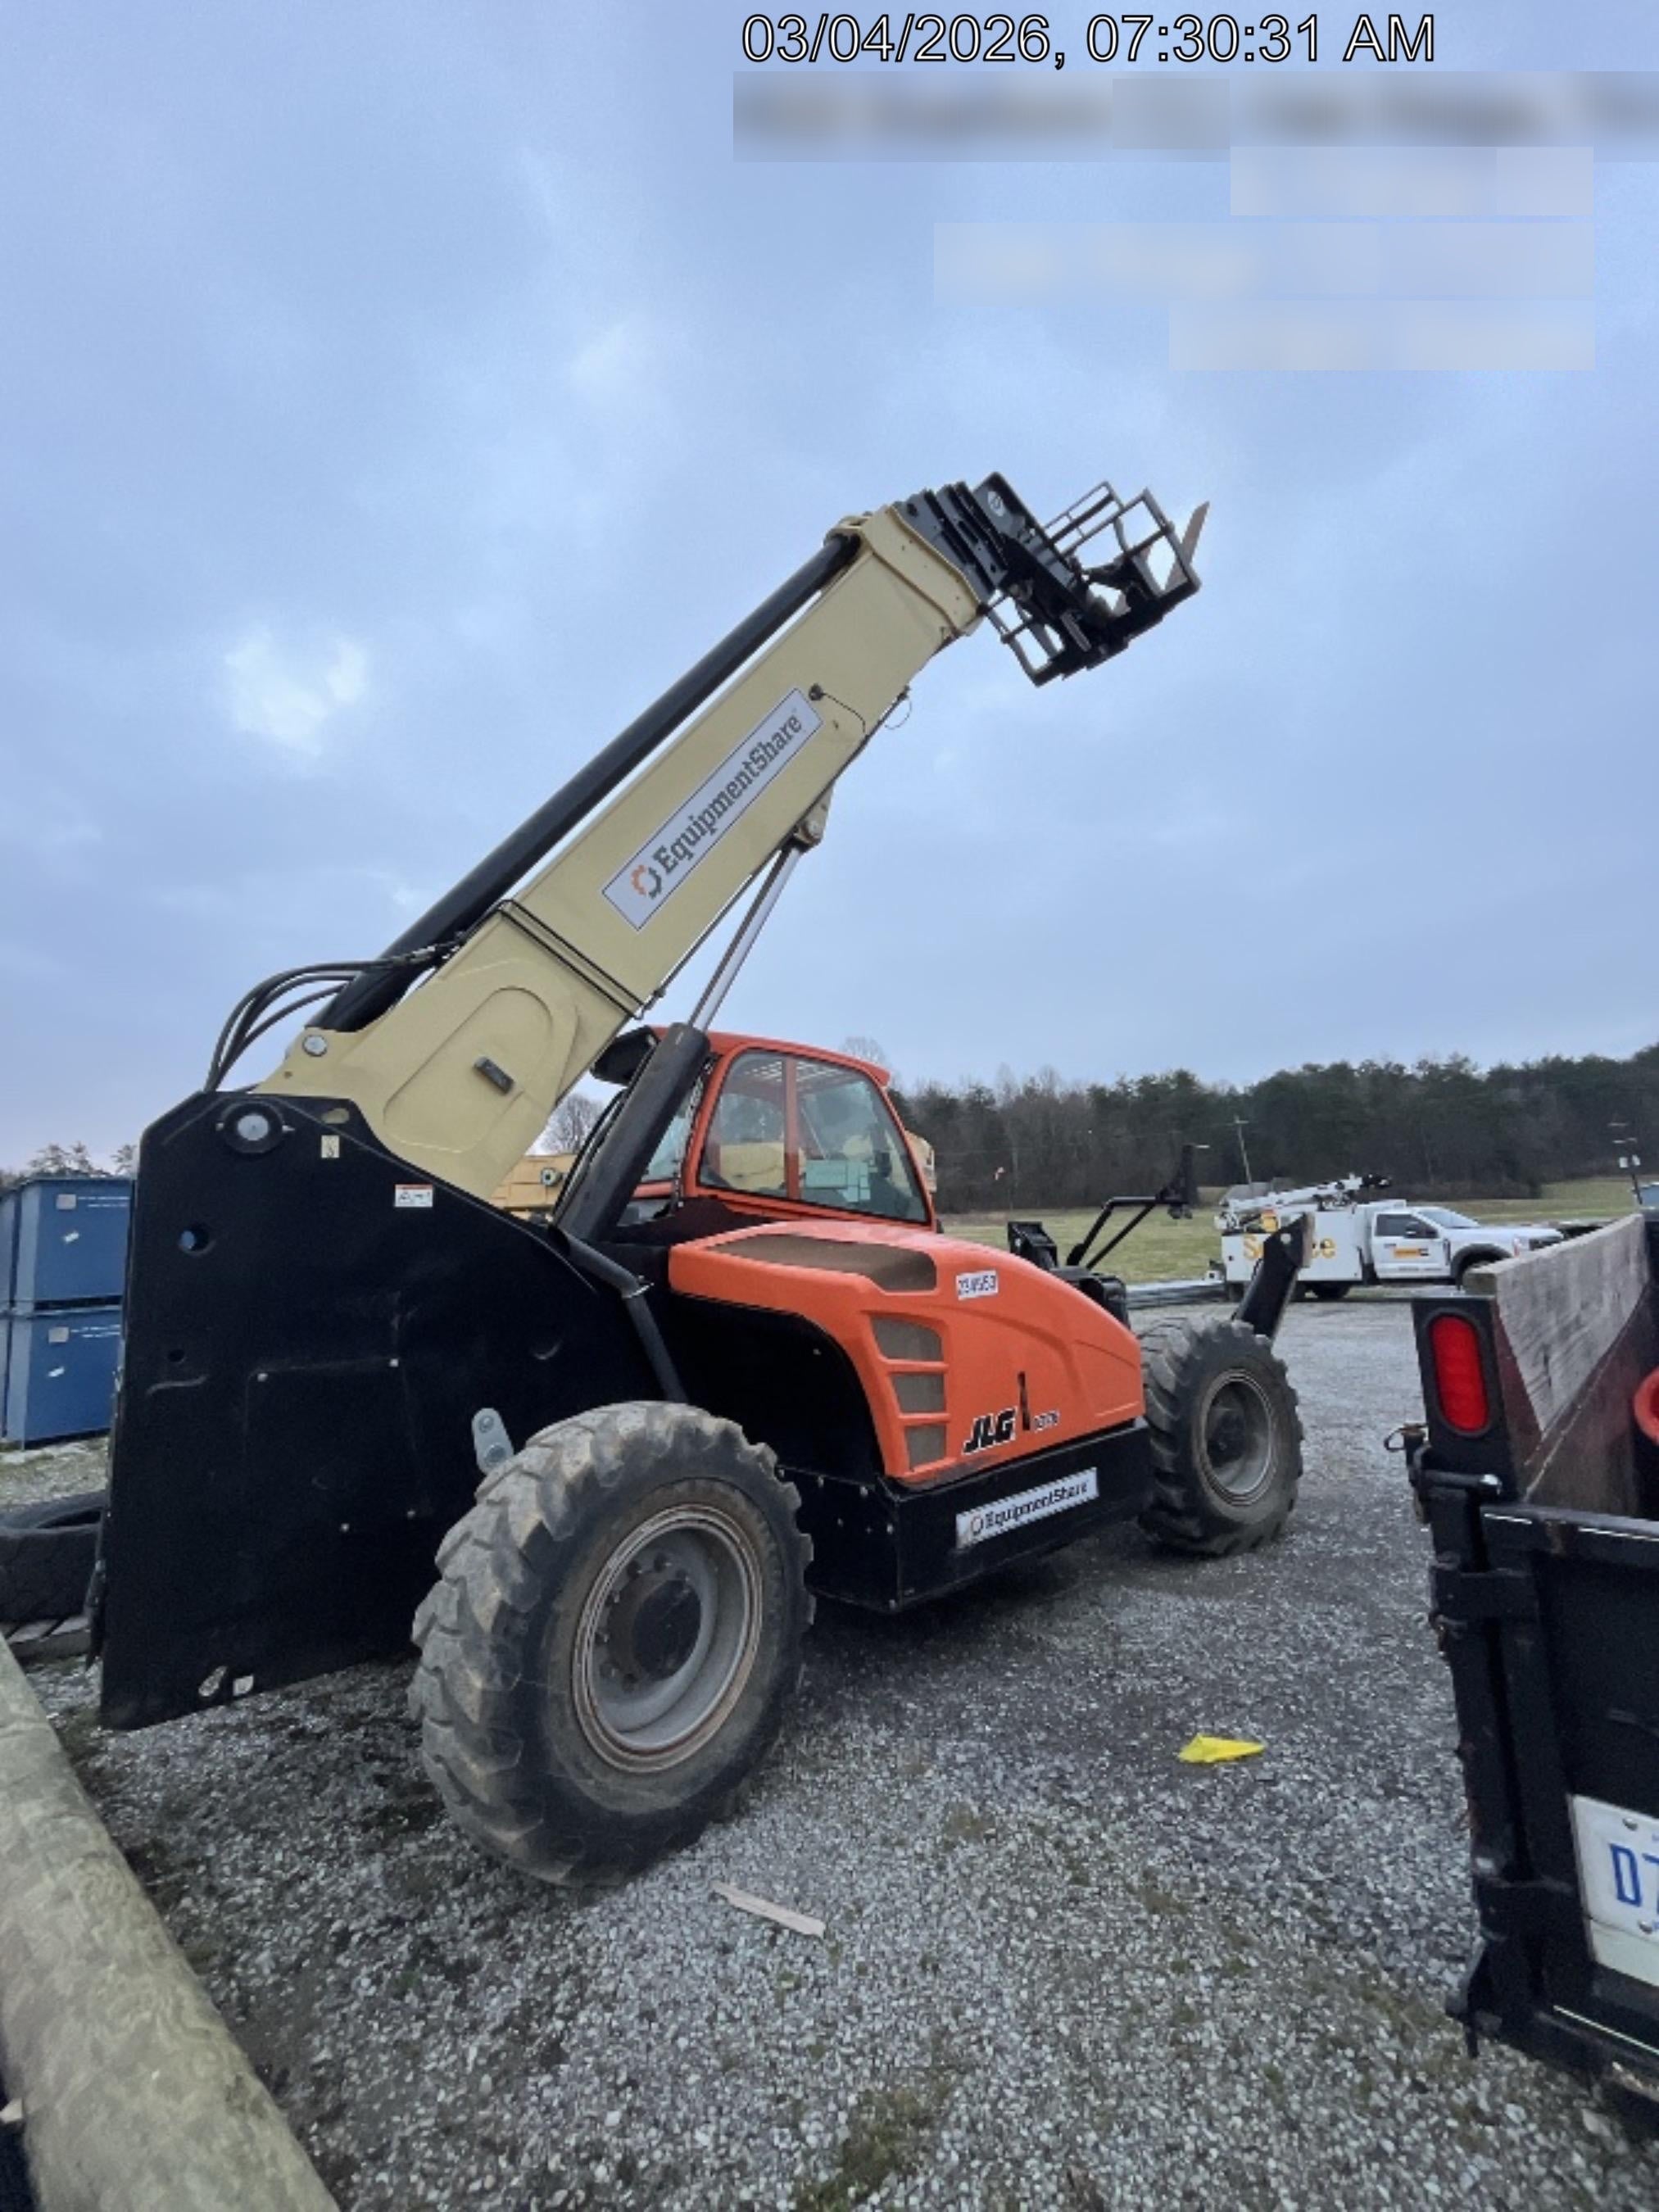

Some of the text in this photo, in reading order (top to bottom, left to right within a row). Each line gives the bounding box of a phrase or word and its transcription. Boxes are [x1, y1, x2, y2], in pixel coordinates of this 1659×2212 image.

[651, 714, 802, 874] EquipmentShare
[963, 1407, 1017, 1454] JLG
[985, 1481, 1088, 1530] EquipmentShare
